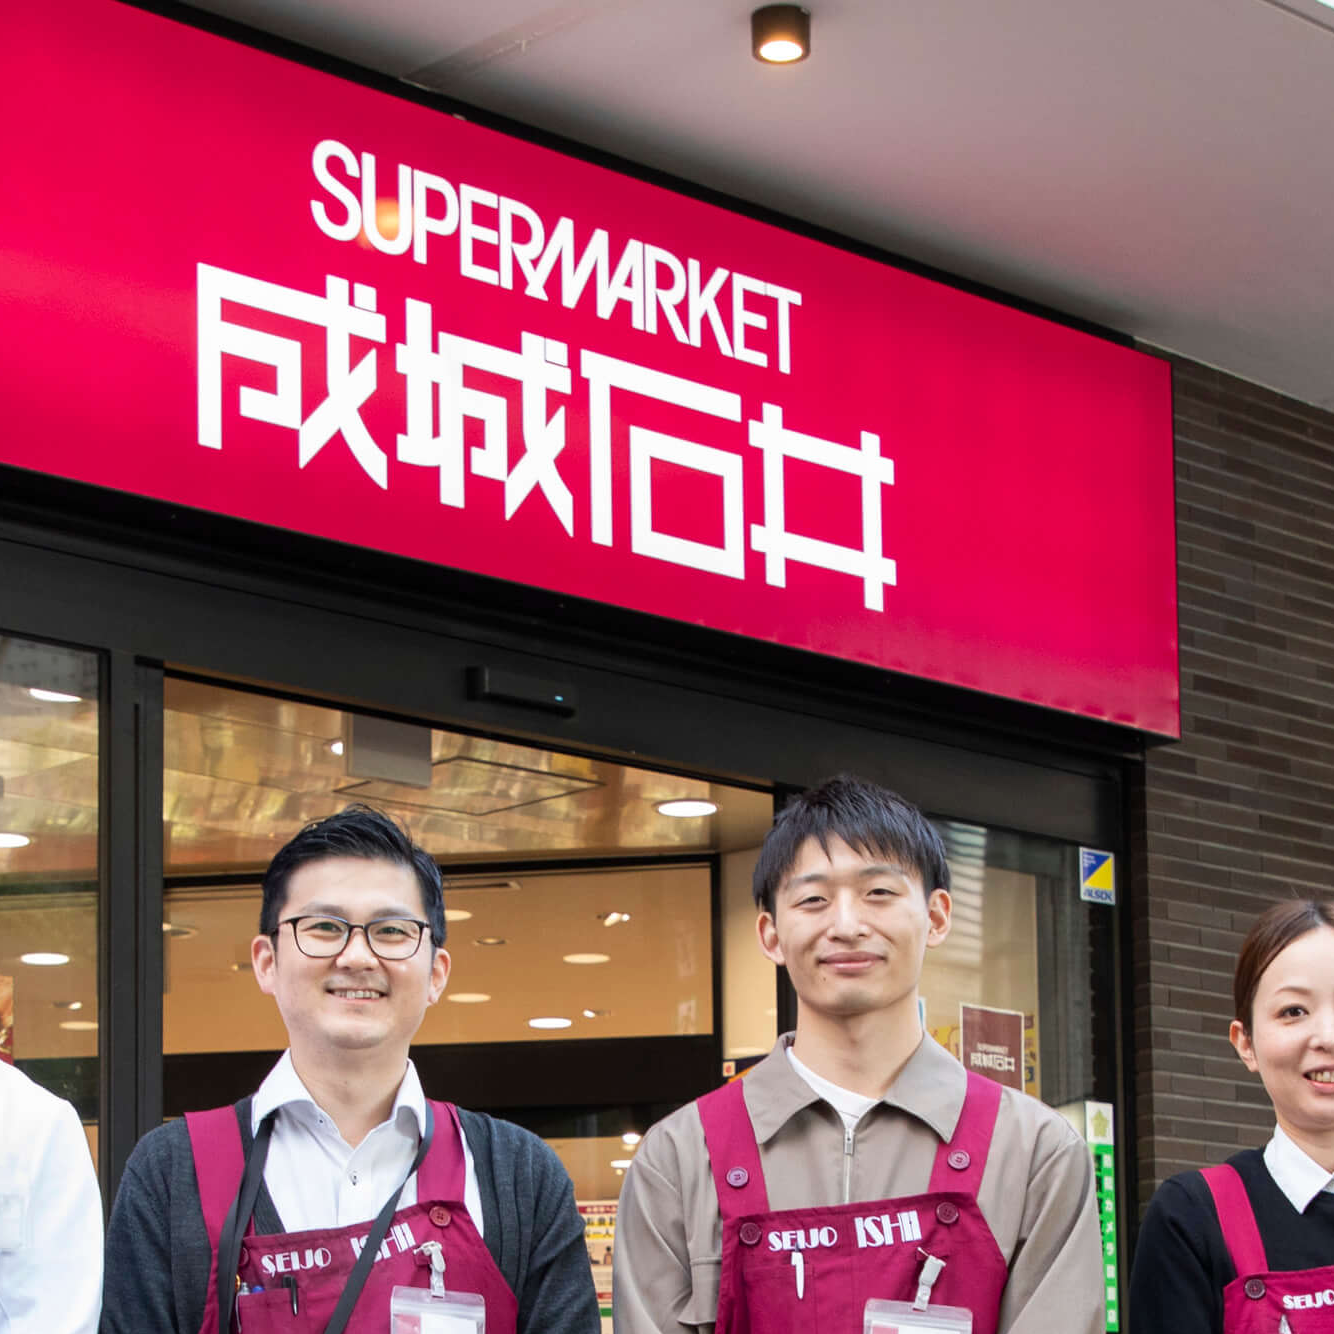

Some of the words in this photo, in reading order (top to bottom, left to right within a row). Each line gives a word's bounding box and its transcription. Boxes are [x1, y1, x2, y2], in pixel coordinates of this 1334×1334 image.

[310, 139, 801, 374] SUPERMARKET
[197, 261, 897, 612] 成城石井
[261, 1247, 332, 1278] SEIJO
[767, 1226, 838, 1252] SEIJO
[854, 1210, 923, 1249] ISHII
